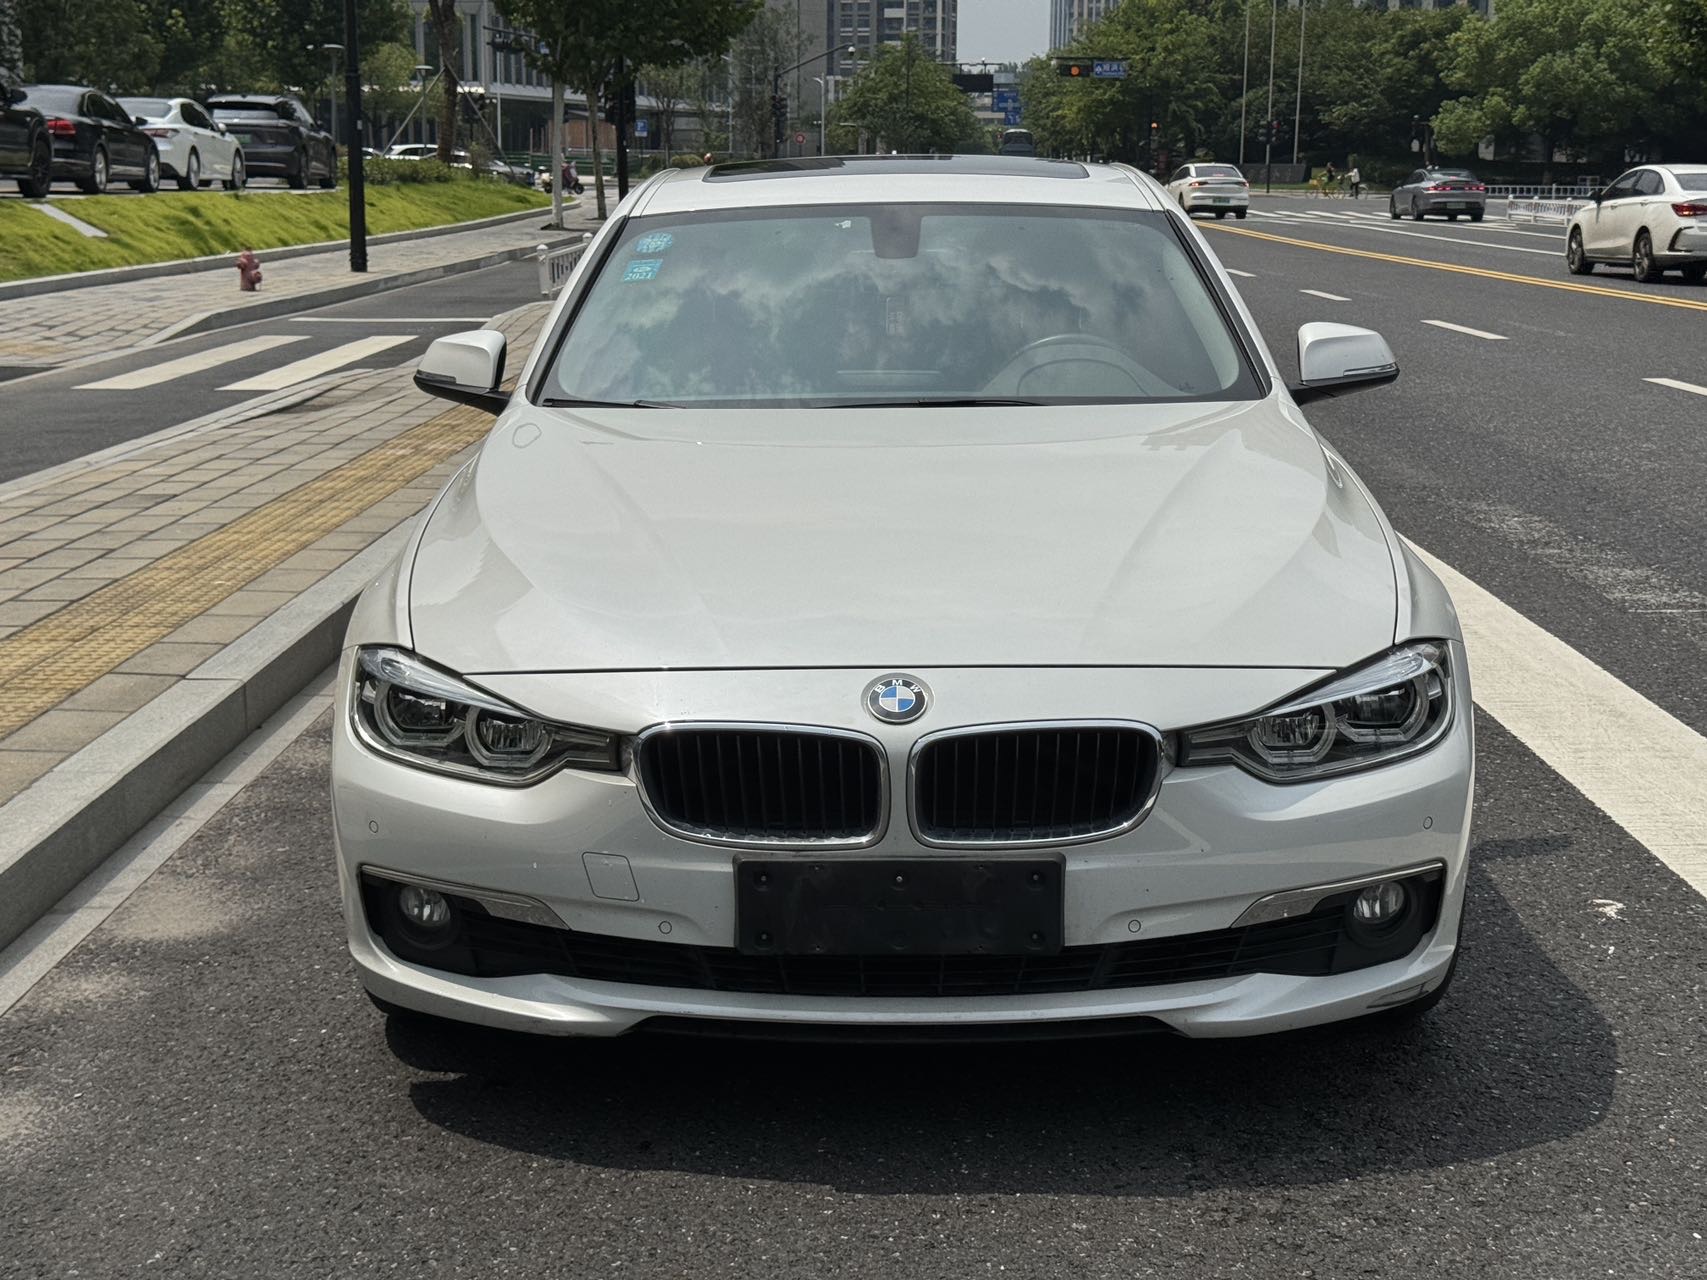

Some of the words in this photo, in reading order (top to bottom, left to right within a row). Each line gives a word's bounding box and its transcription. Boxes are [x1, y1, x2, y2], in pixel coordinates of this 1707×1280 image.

[637, 121, 645, 131] P
[624, 272, 652, 281] 2021
[874, 679, 921, 693] BMW
